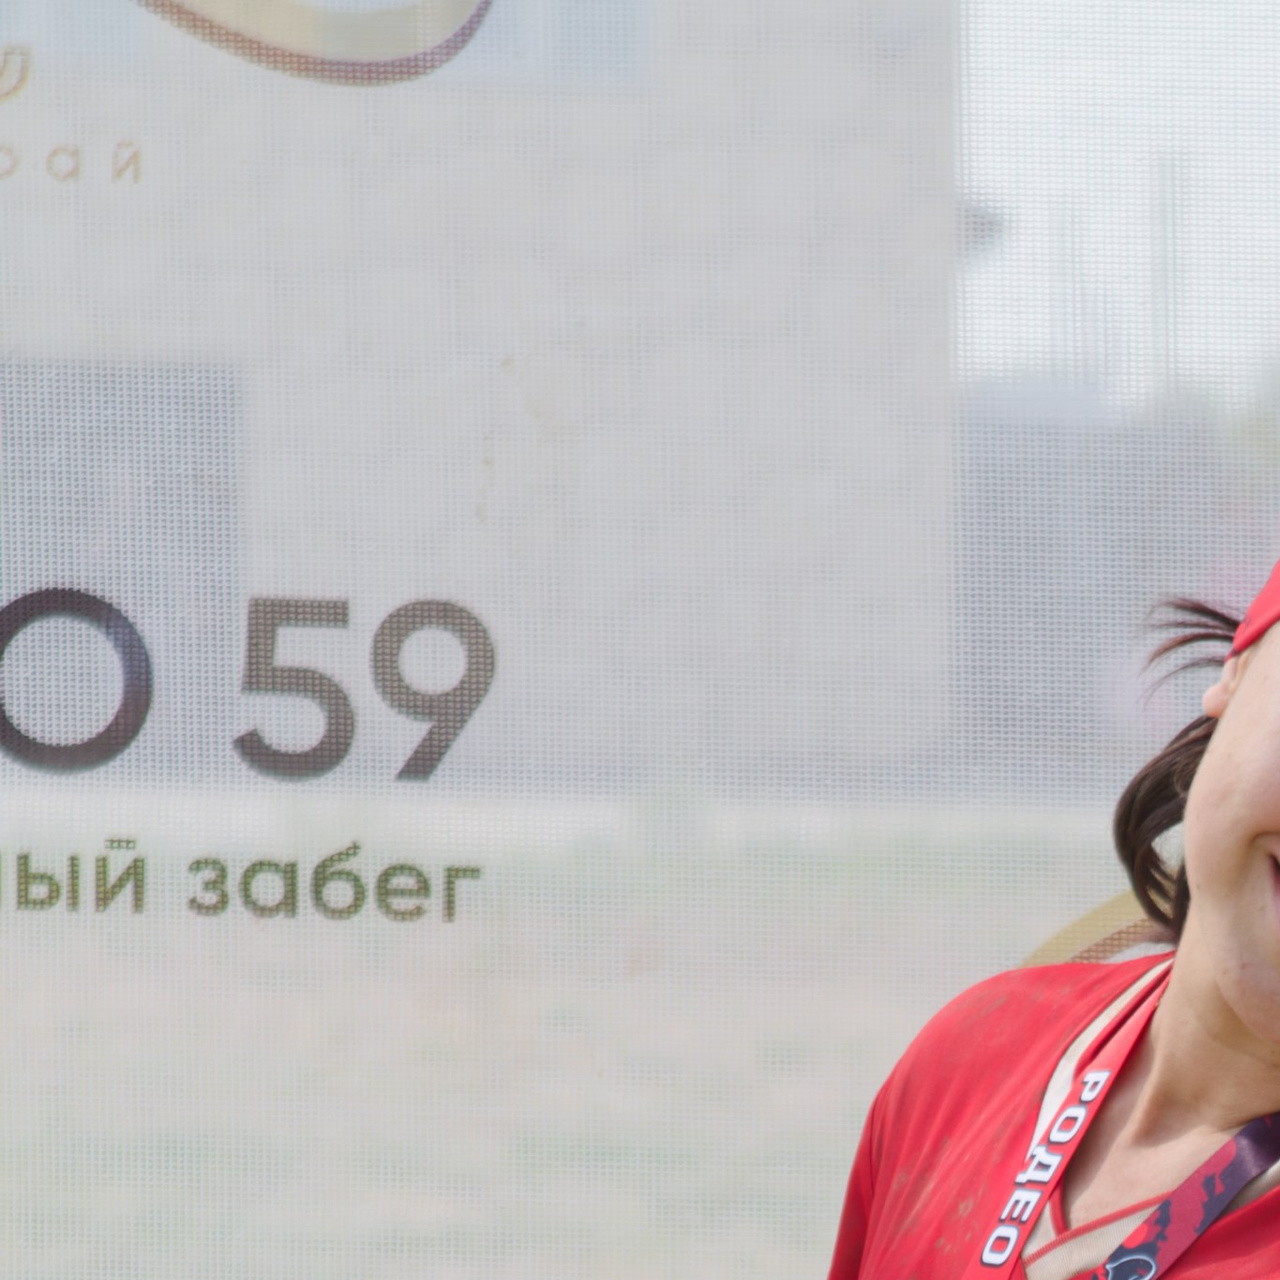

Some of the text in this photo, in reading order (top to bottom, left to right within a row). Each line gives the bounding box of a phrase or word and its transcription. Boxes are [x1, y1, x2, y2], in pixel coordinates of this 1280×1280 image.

[232, 599, 495, 781] 59
[187, 841, 481, 923] забег
[981, 1068, 1112, 1267] РОДЕО
